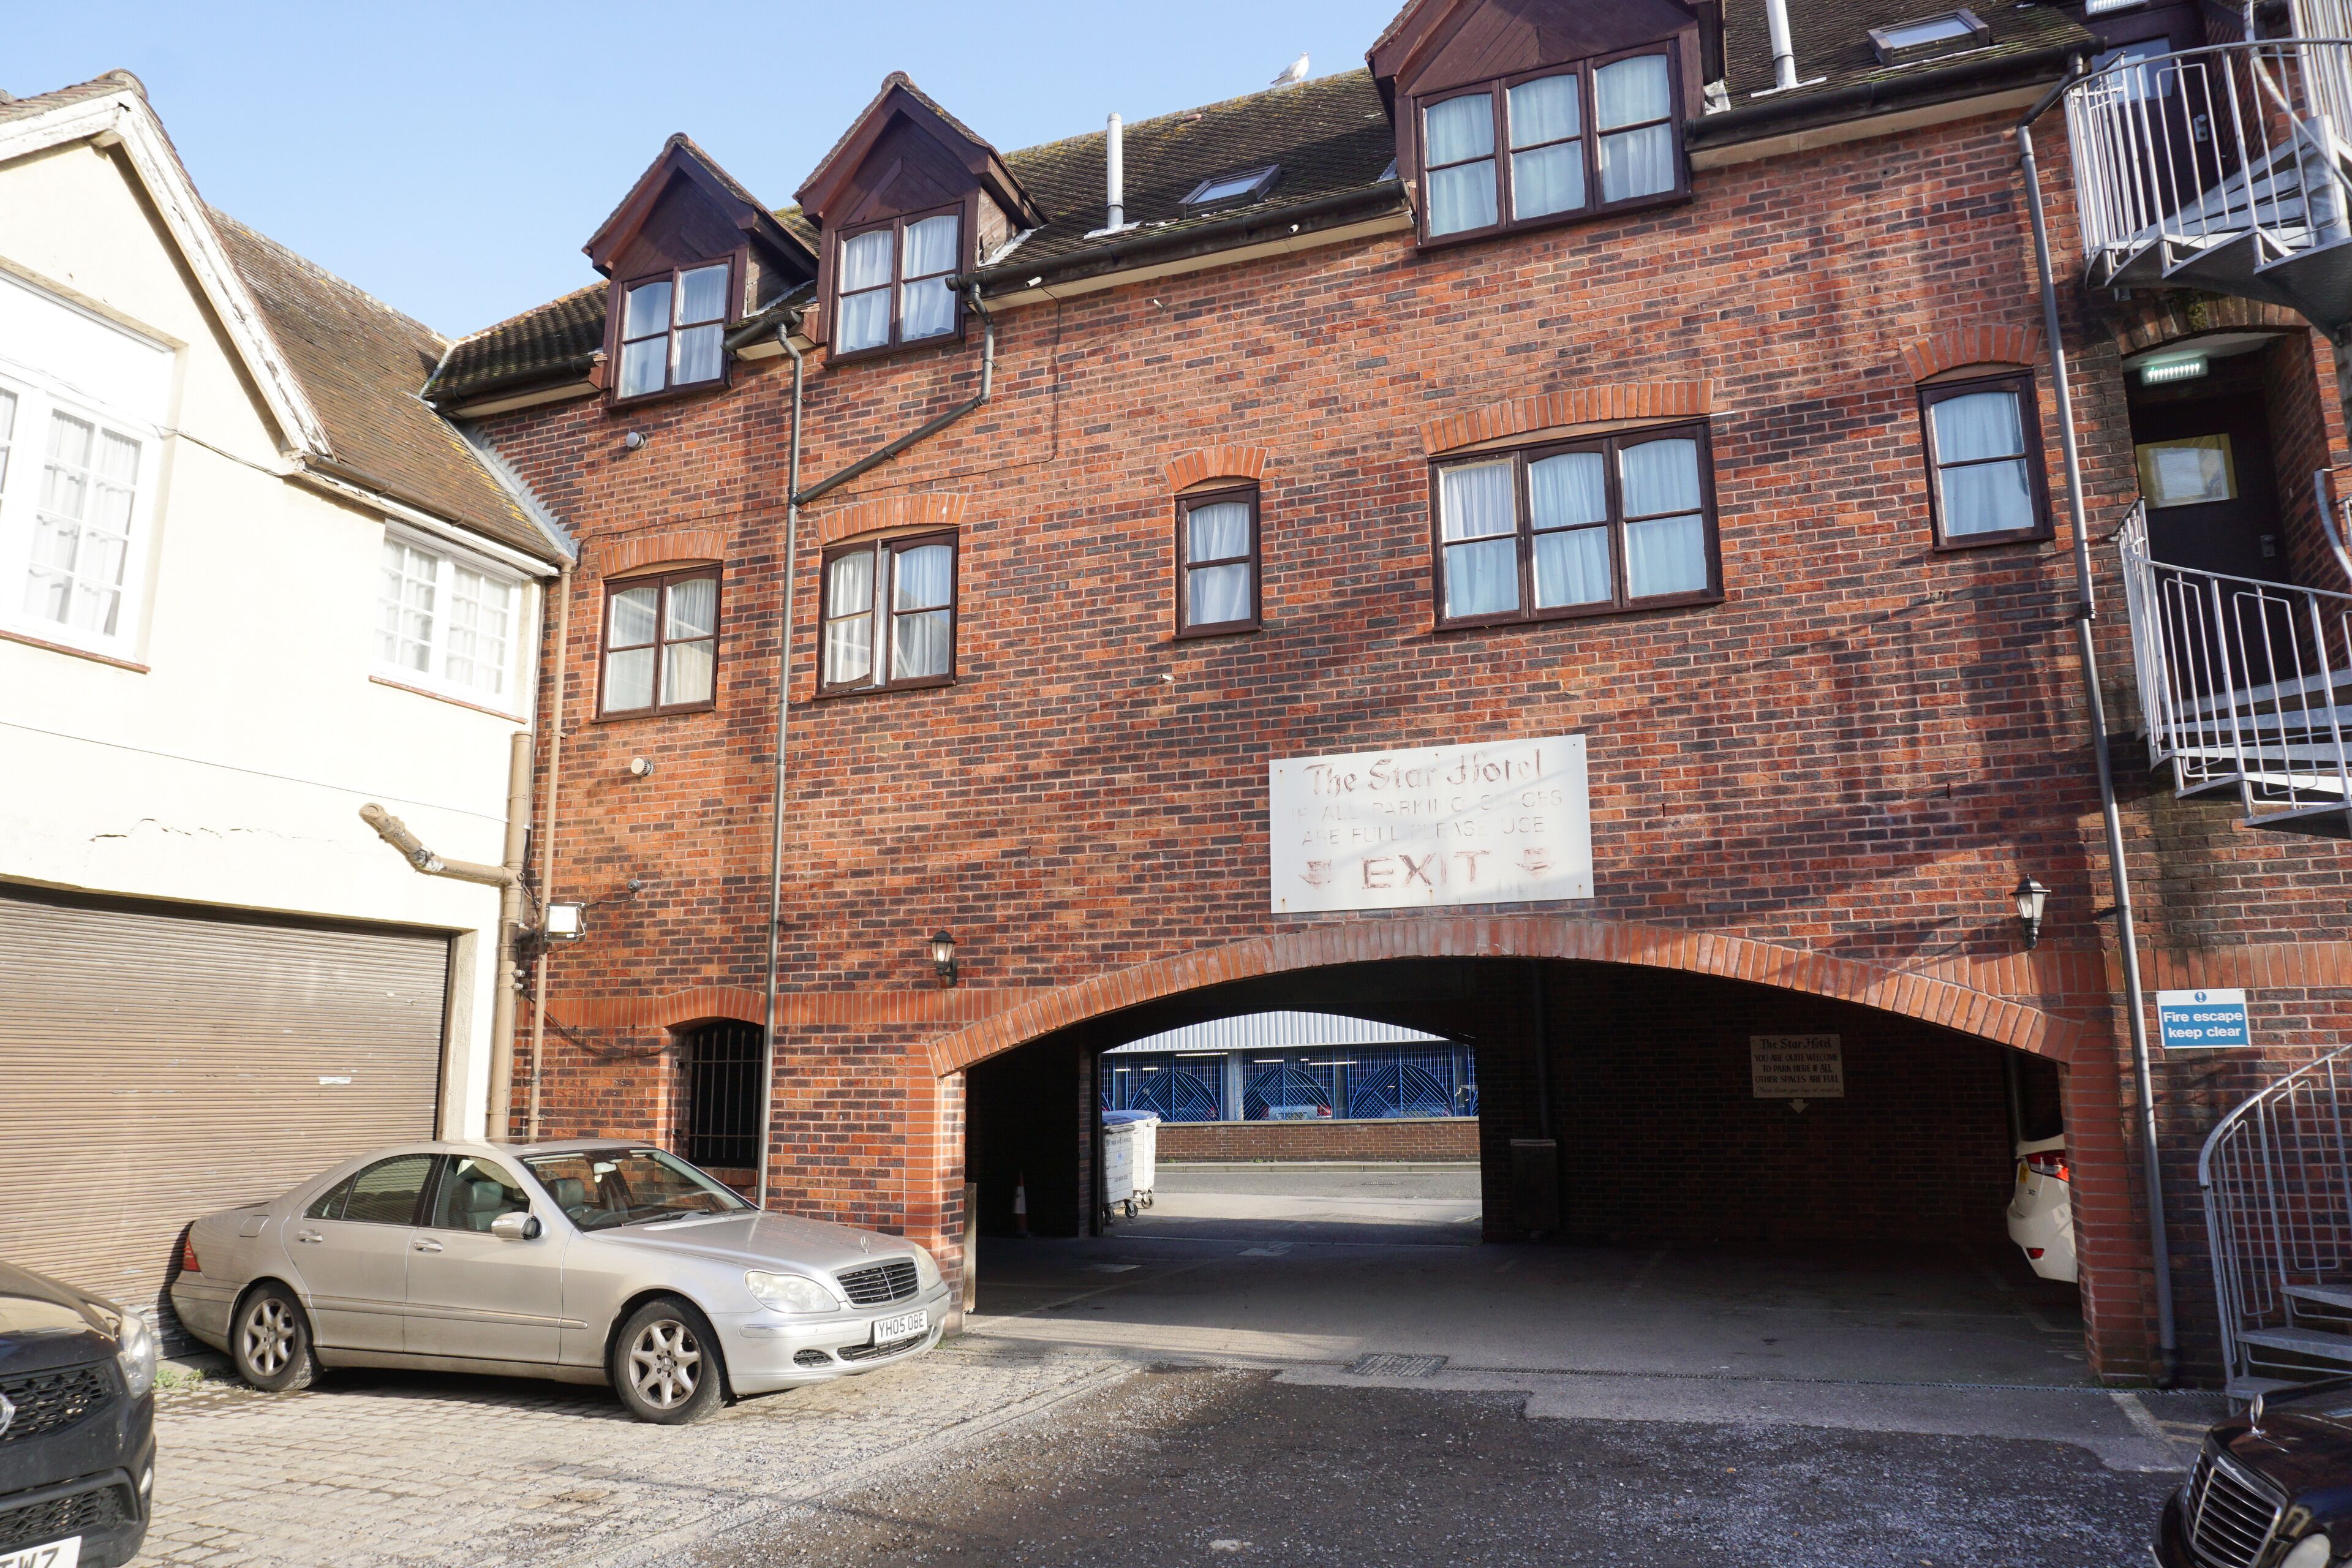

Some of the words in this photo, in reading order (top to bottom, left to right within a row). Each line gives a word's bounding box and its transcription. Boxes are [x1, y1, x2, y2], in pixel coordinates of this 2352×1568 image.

[1303, 762, 1357, 797] The
[1368, 757, 1438, 791] Star
[1447, 748, 1540, 785] Hotel
[1322, 805, 1360, 821] ALL
[1352, 825, 1399, 844] FULL
[1501, 816, 1544, 834] USE
[1362, 850, 1492, 889] EXIT
[2163, 1012, 2189, 1022] Fire
[2193, 1012, 2243, 1023] escape
[2168, 1027, 2203, 1039] keep
[2206, 1027, 2242, 1037] clear
[1760, 1038, 1777, 1049] The
[1780, 1038, 1803, 1049] Star
[1804, 1038, 1832, 1049] Hotel
[1820, 1063, 1833, 1072] ALL
[878, 1317, 905, 1338] YH05
